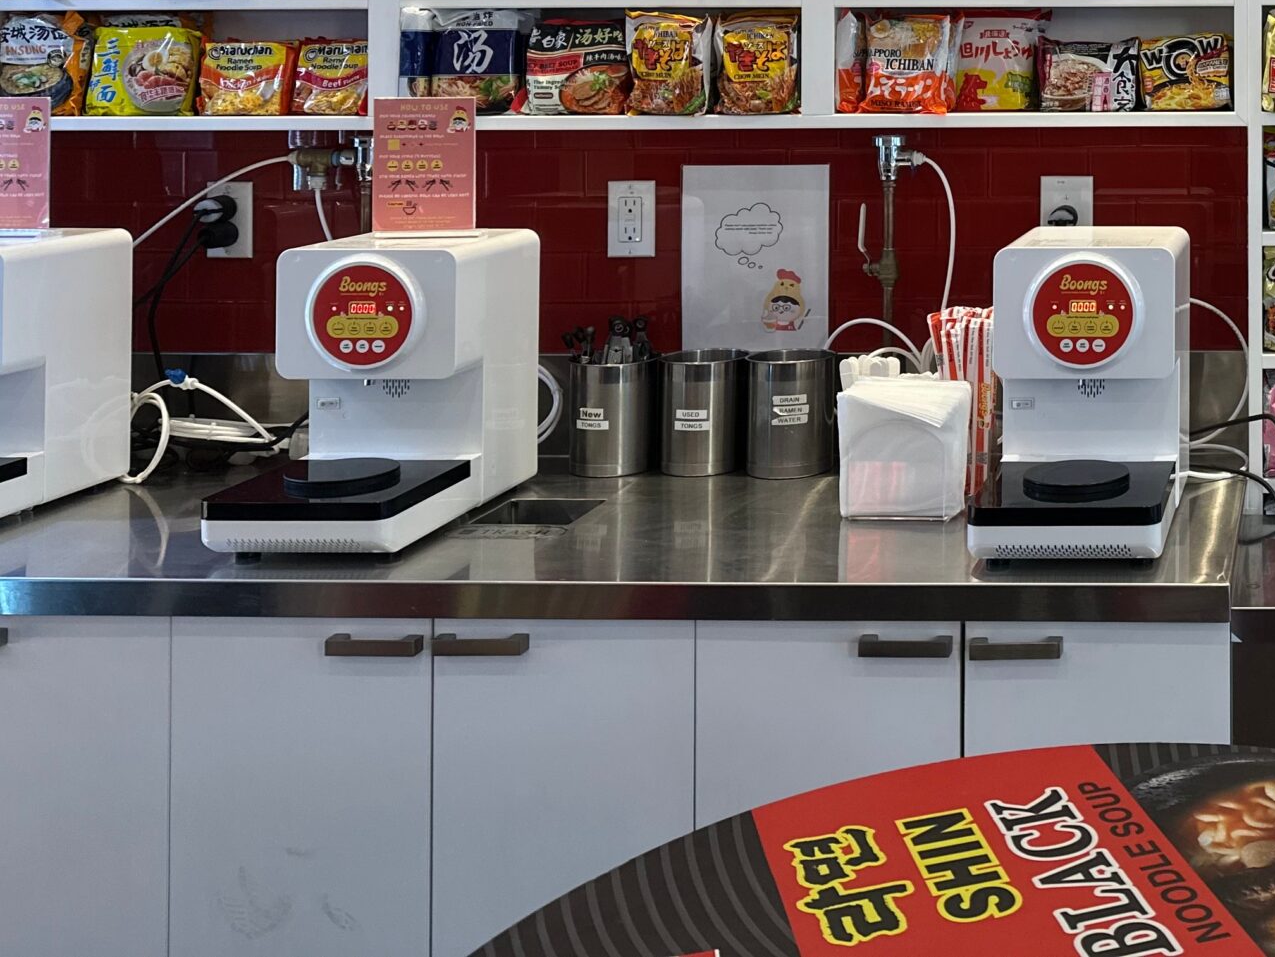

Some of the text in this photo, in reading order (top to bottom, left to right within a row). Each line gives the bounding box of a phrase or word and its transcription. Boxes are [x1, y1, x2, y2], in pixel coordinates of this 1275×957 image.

[452, 28, 495, 75] 汤
[884, 57, 935, 72] ICHIBAN
[338, 275, 388, 299] Boongs
[1059, 274, 1108, 296] Boongs
[779, 396, 800, 404] DRAIN
[582, 410, 602, 419] New
[896, 808, 1023, 923] SHIN
[1078, 781, 1231, 944] NOODLE SOUP
